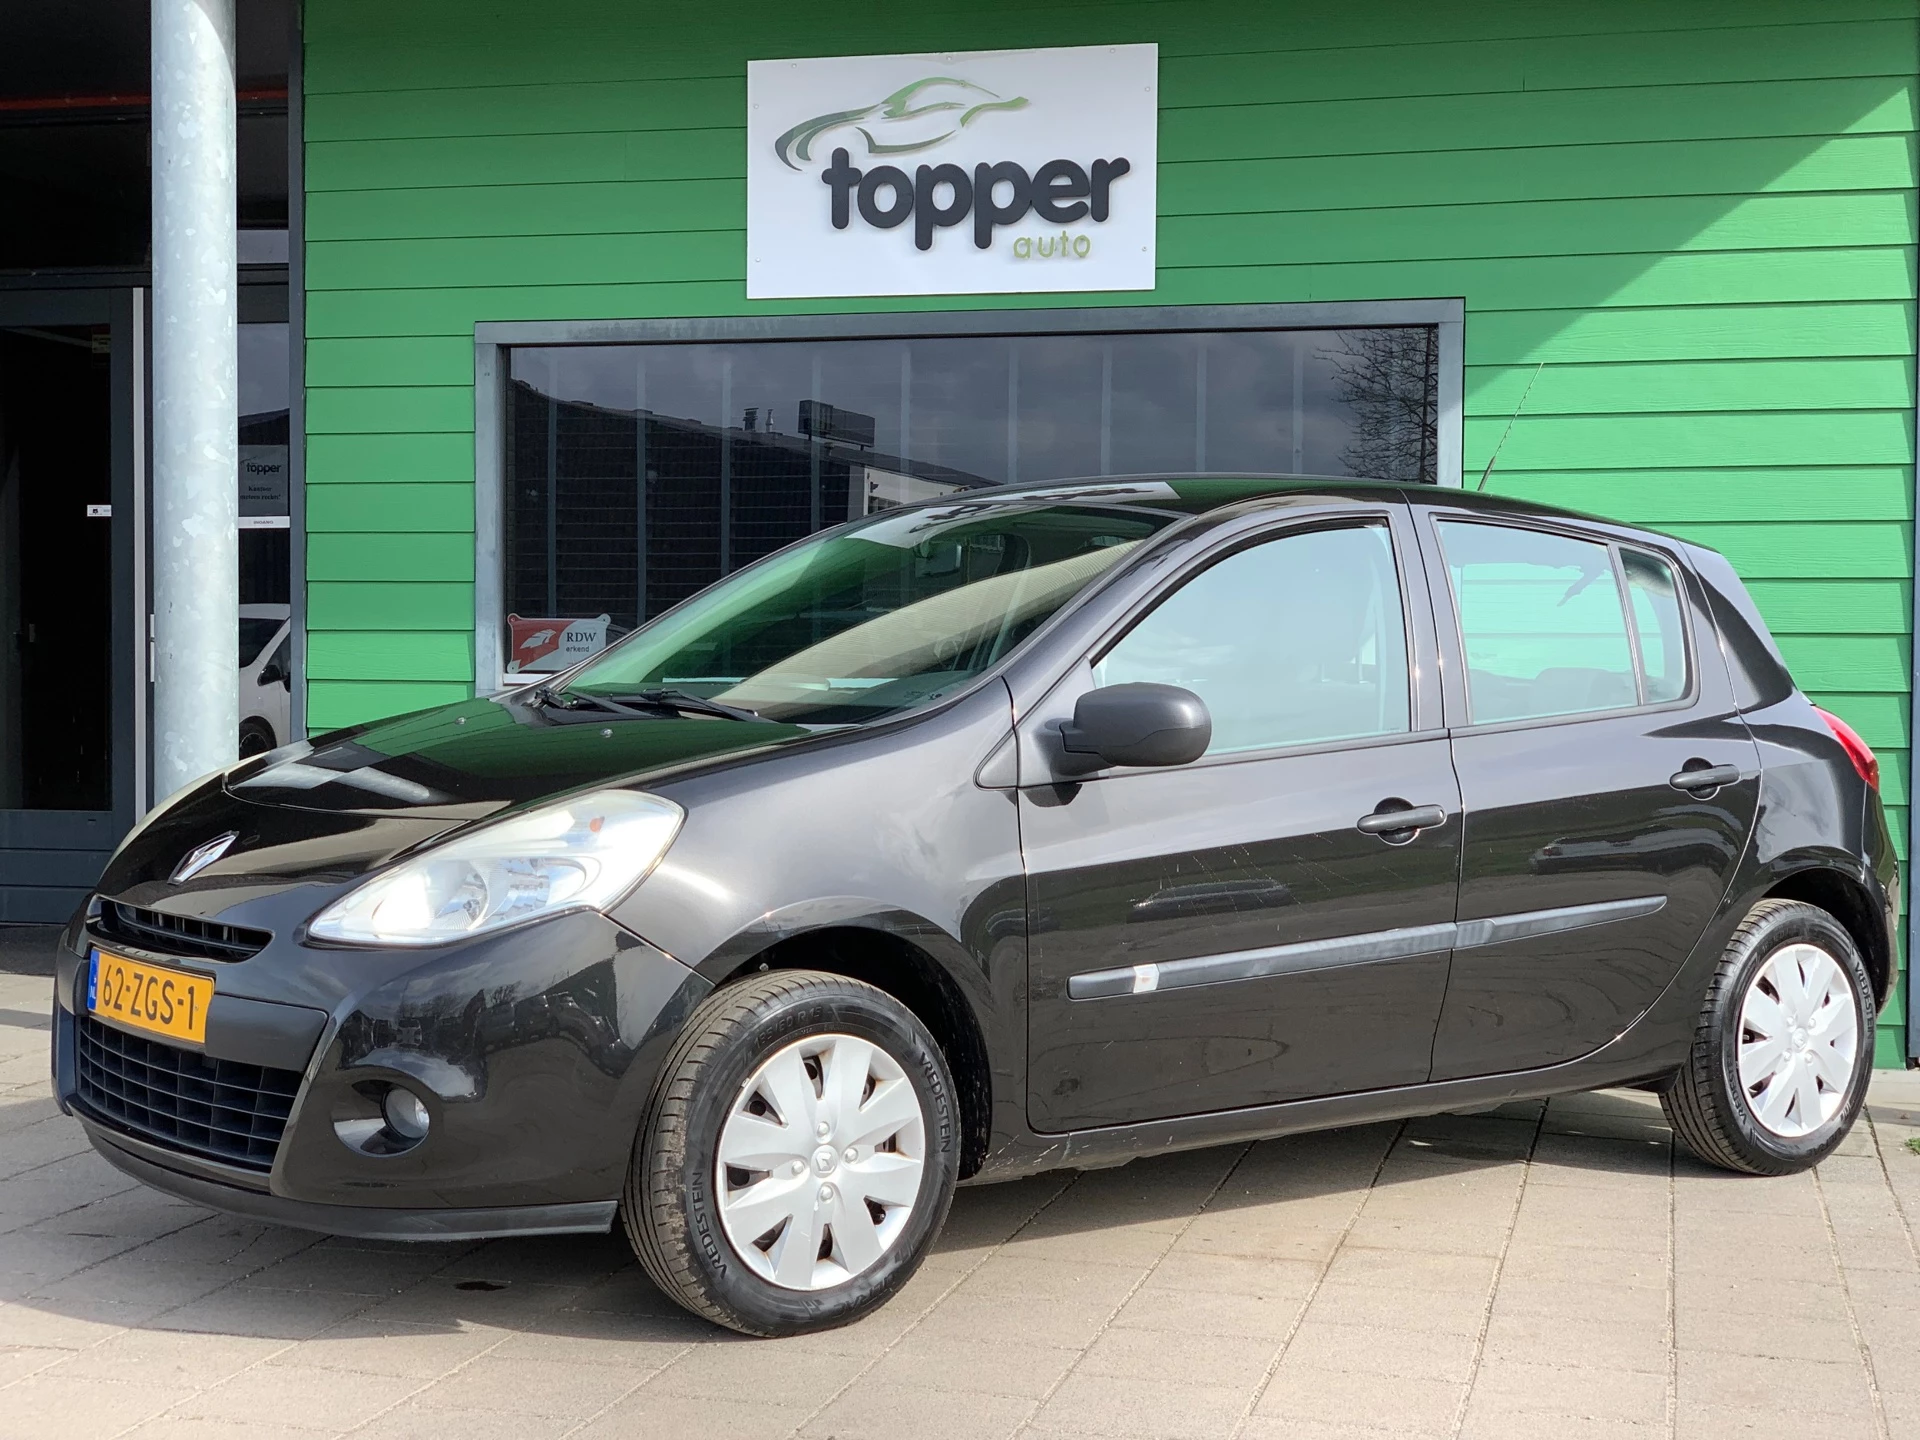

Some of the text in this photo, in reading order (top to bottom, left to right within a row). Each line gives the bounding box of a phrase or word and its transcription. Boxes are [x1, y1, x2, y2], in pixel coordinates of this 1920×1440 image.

[821, 147, 1130, 251] topper
[1013, 231, 1091, 258] auto
[246, 463, 281, 475] topper
[565, 645, 589, 653] erkend
[566, 632, 597, 642] RDW
[103, 964, 195, 1030] 62-ZGS-1
[1855, 961, 1876, 1040] VREDESTEIN
[920, 1052, 952, 1153] VREDESTEIN
[691, 1172, 728, 1280] VREDESTEIN
